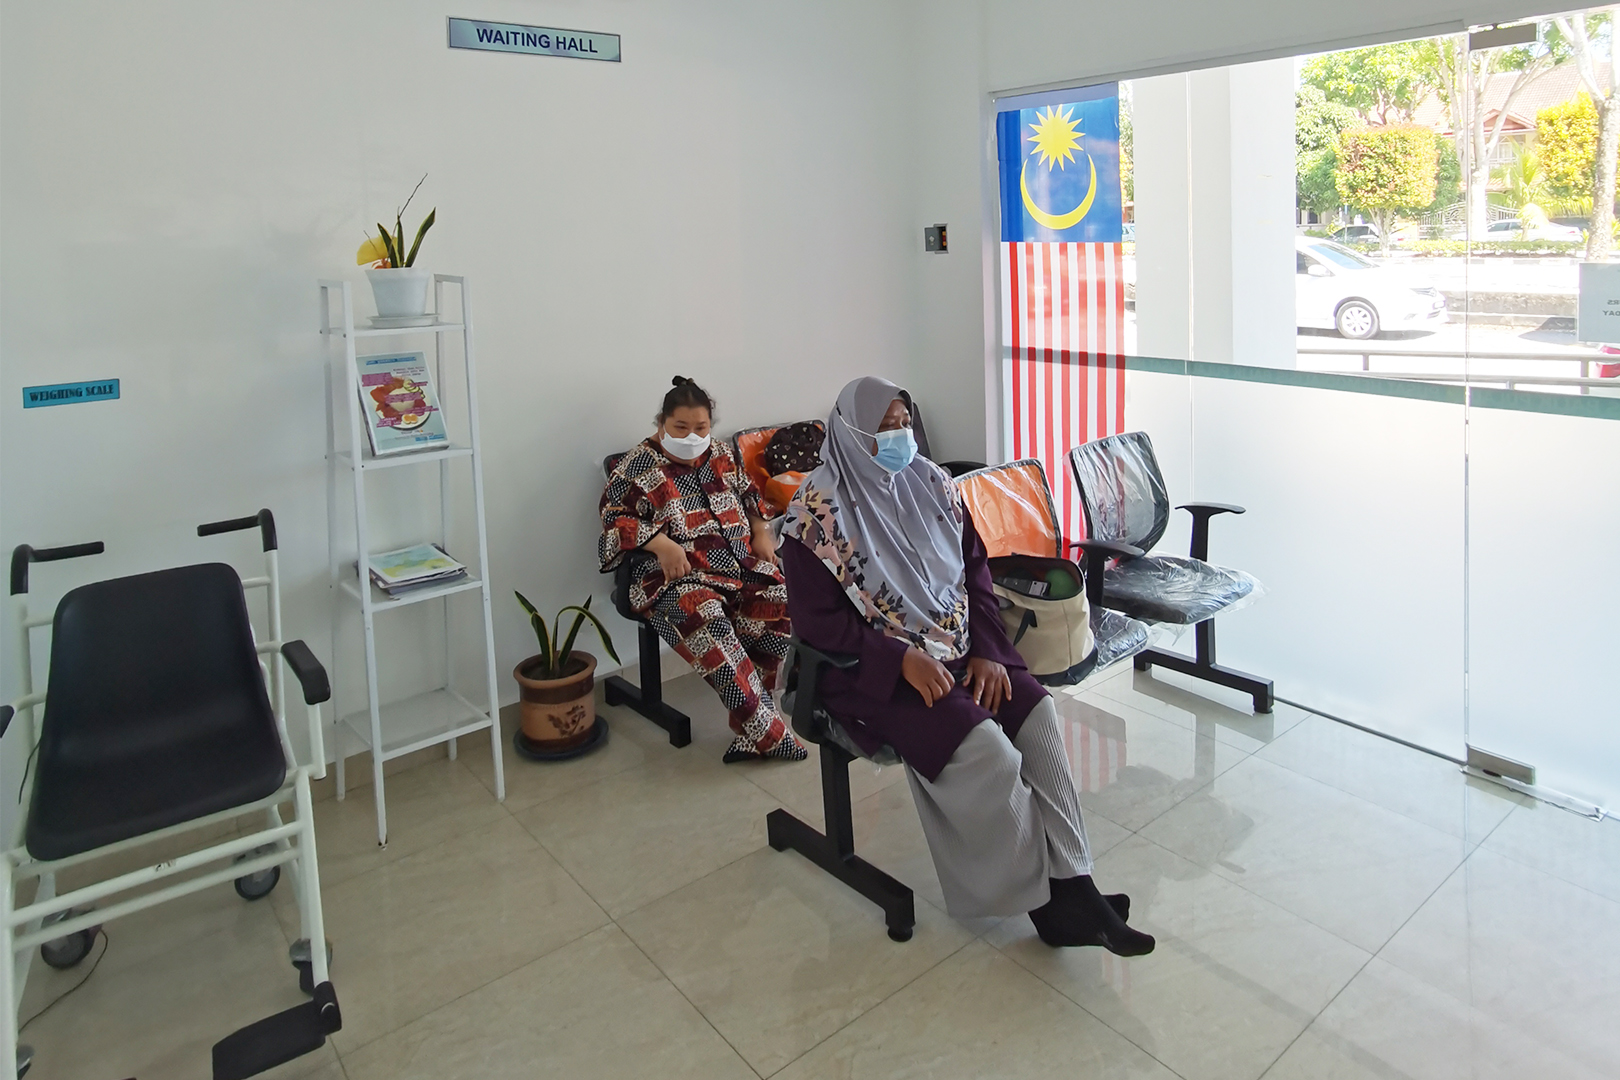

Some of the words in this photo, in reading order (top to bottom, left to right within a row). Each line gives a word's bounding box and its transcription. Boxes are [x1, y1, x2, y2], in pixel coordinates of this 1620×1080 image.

[476, 28, 550, 49] WAITING
[556, 36, 598, 53] HALL
[29, 387, 83, 402] WEIGHING
[86, 384, 114, 396] SCALE
